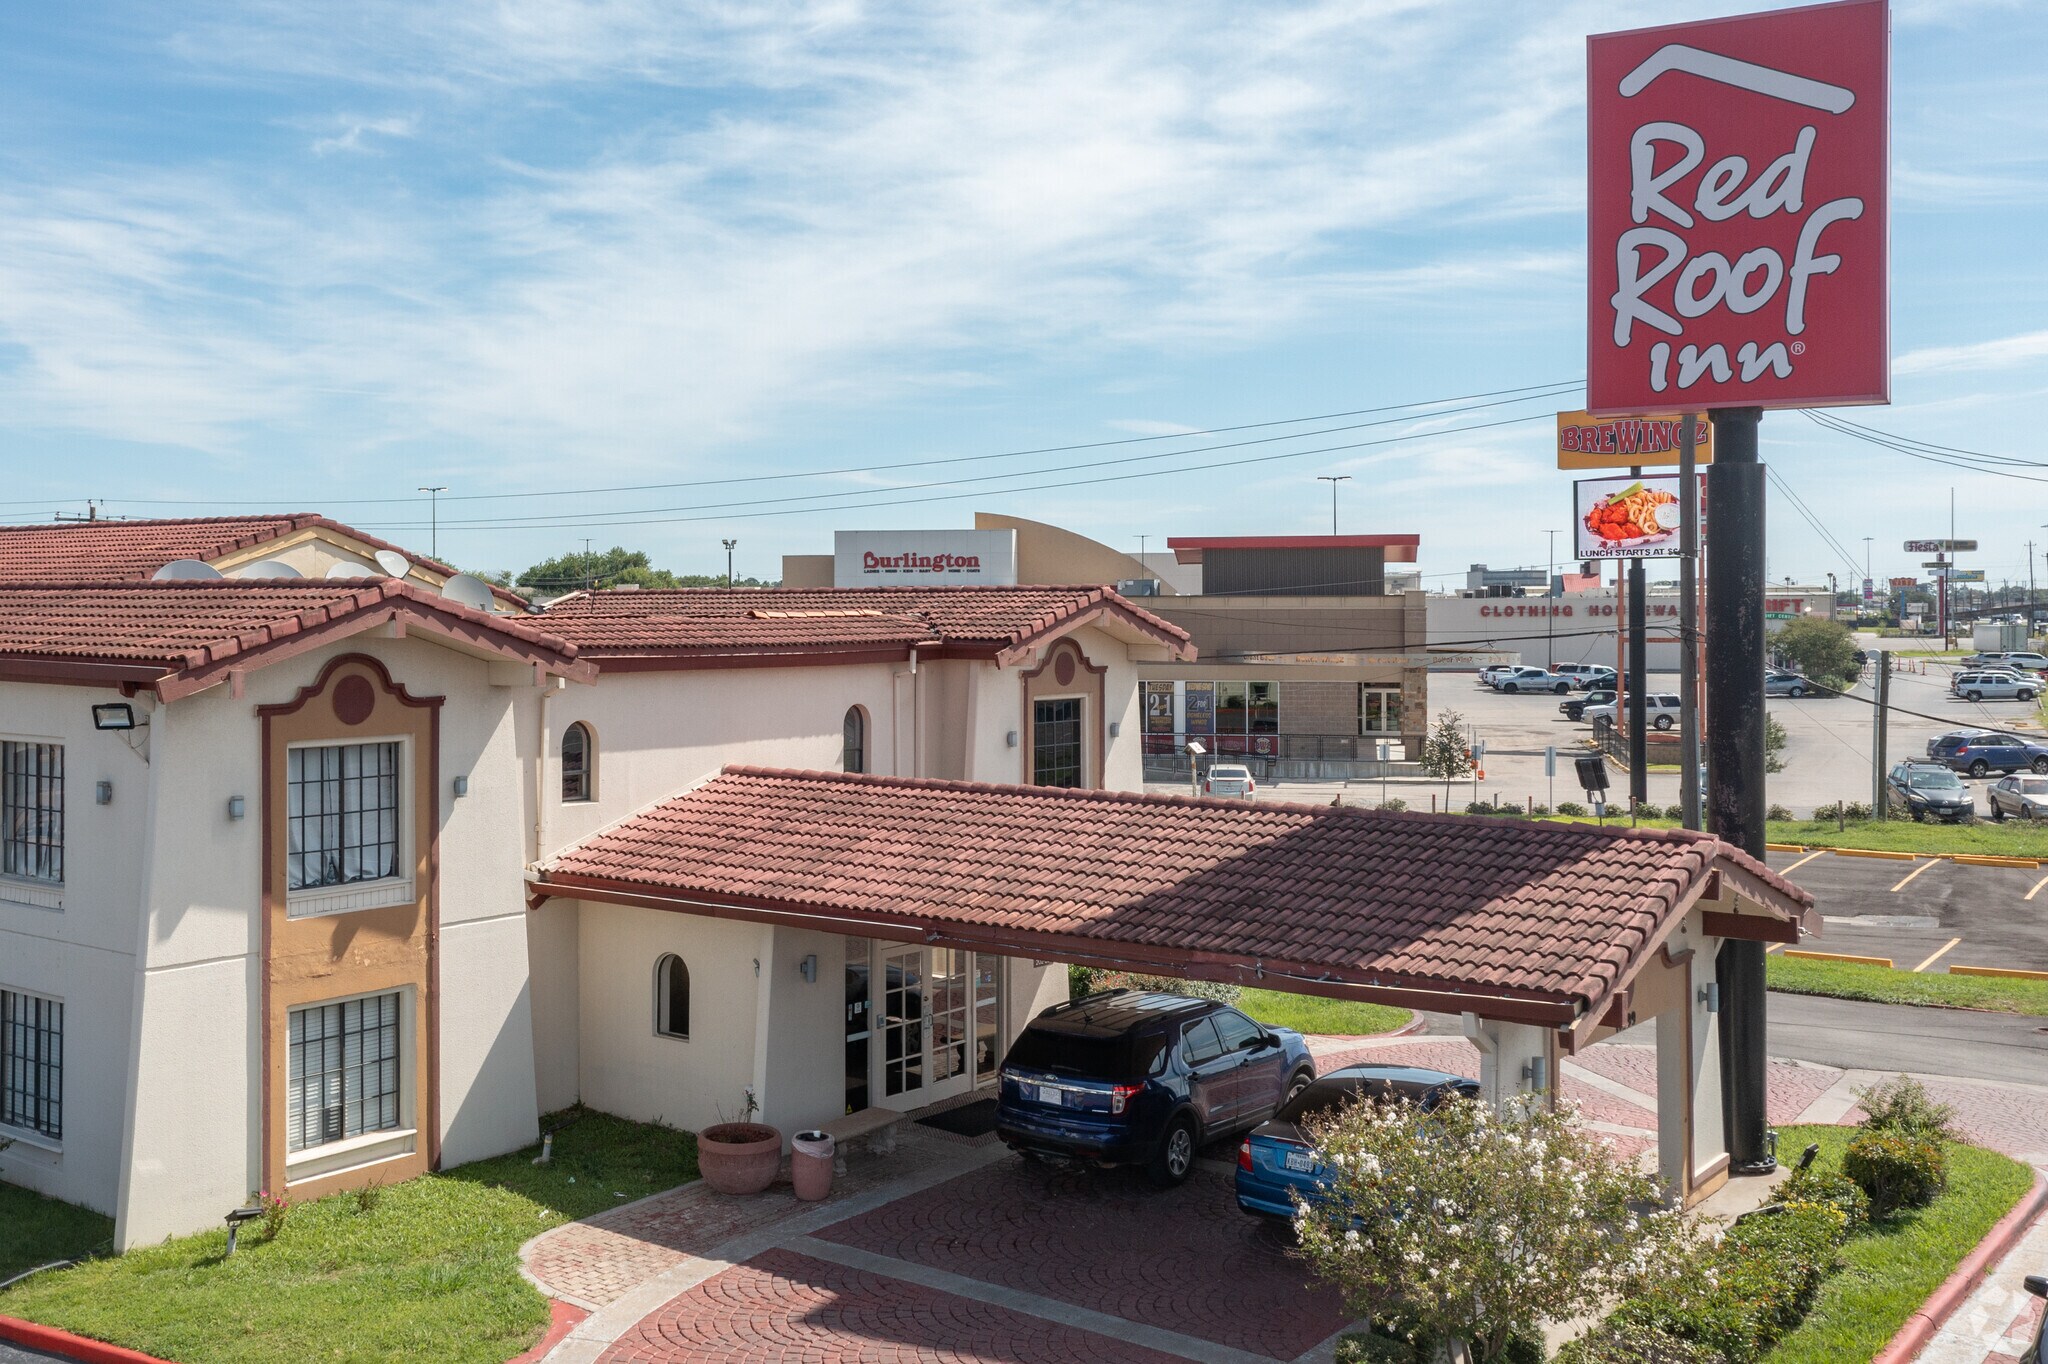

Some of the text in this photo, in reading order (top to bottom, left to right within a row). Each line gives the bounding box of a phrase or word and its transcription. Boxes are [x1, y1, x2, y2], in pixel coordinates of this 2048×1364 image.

[1630, 121, 1817, 228] Red
[1611, 197, 1864, 347] Roof
[1653, 548, 1665, 556] AT
[1907, 541, 1939, 551] Fiesta
[863, 551, 980, 572] Burlington
[1479, 605, 1574, 617] CLOTHING
[1149, 694, 1160, 716] 2
[1164, 694, 1173, 716] 1
[1187, 694, 1199, 712] 2
[1204, 694, 1213, 712] 1
